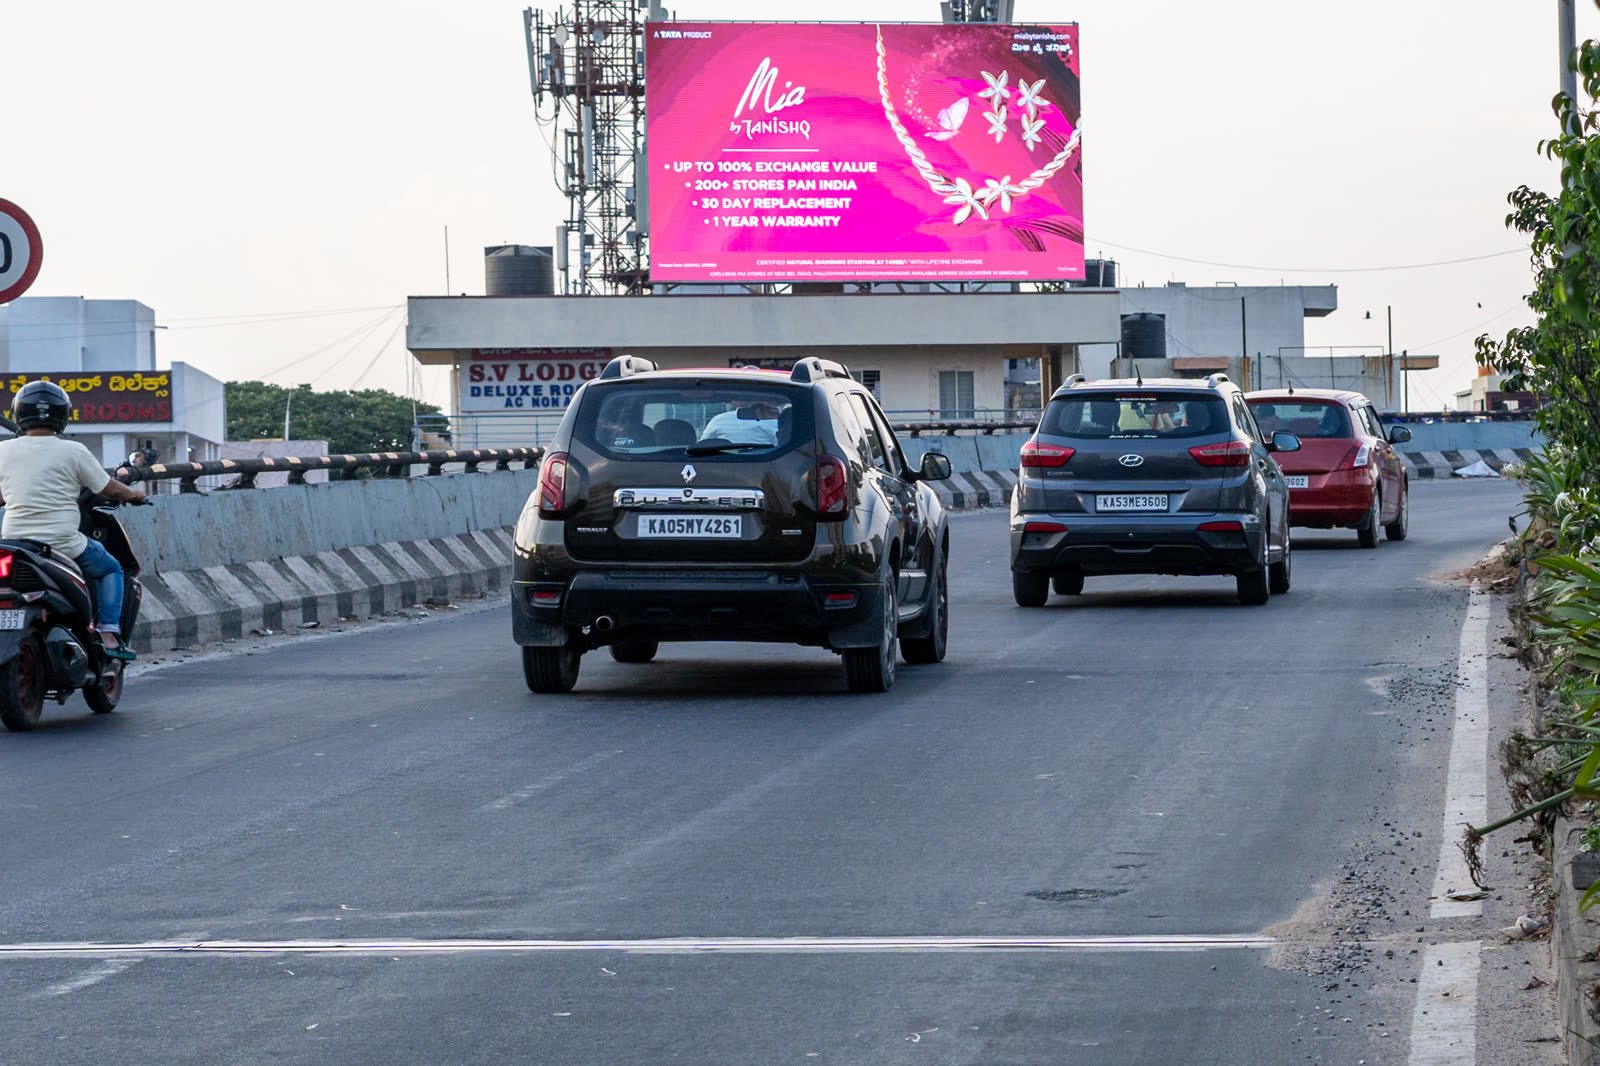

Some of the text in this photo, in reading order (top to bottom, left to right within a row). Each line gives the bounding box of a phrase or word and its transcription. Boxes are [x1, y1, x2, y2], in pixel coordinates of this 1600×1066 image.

[1014, 32, 1070, 40] miabytanishq.com
[734, 57, 806, 118] Mia
[730, 121, 742, 134] by
[674, 162, 878, 172] UP TO 100% EXCHANGE VALUE
[695, 180, 857, 190] 200+ STORES PAN INDIA
[701, 198, 851, 208] 30 DAY REPLACEMENT
[713, 216, 841, 226] 1 YEAR WARRANTY
[469, 363, 509, 383] S.V
[470, 385, 543, 397] DELUXE
[505, 398, 523, 407] AC
[531, 397, 560, 407] NON
[83, 402, 170, 421] ROOMS
[620, 497, 756, 506] DUSTER
[1103, 496, 1167, 508] KA53ME3608
[649, 519, 740, 534] KA05MY4261
